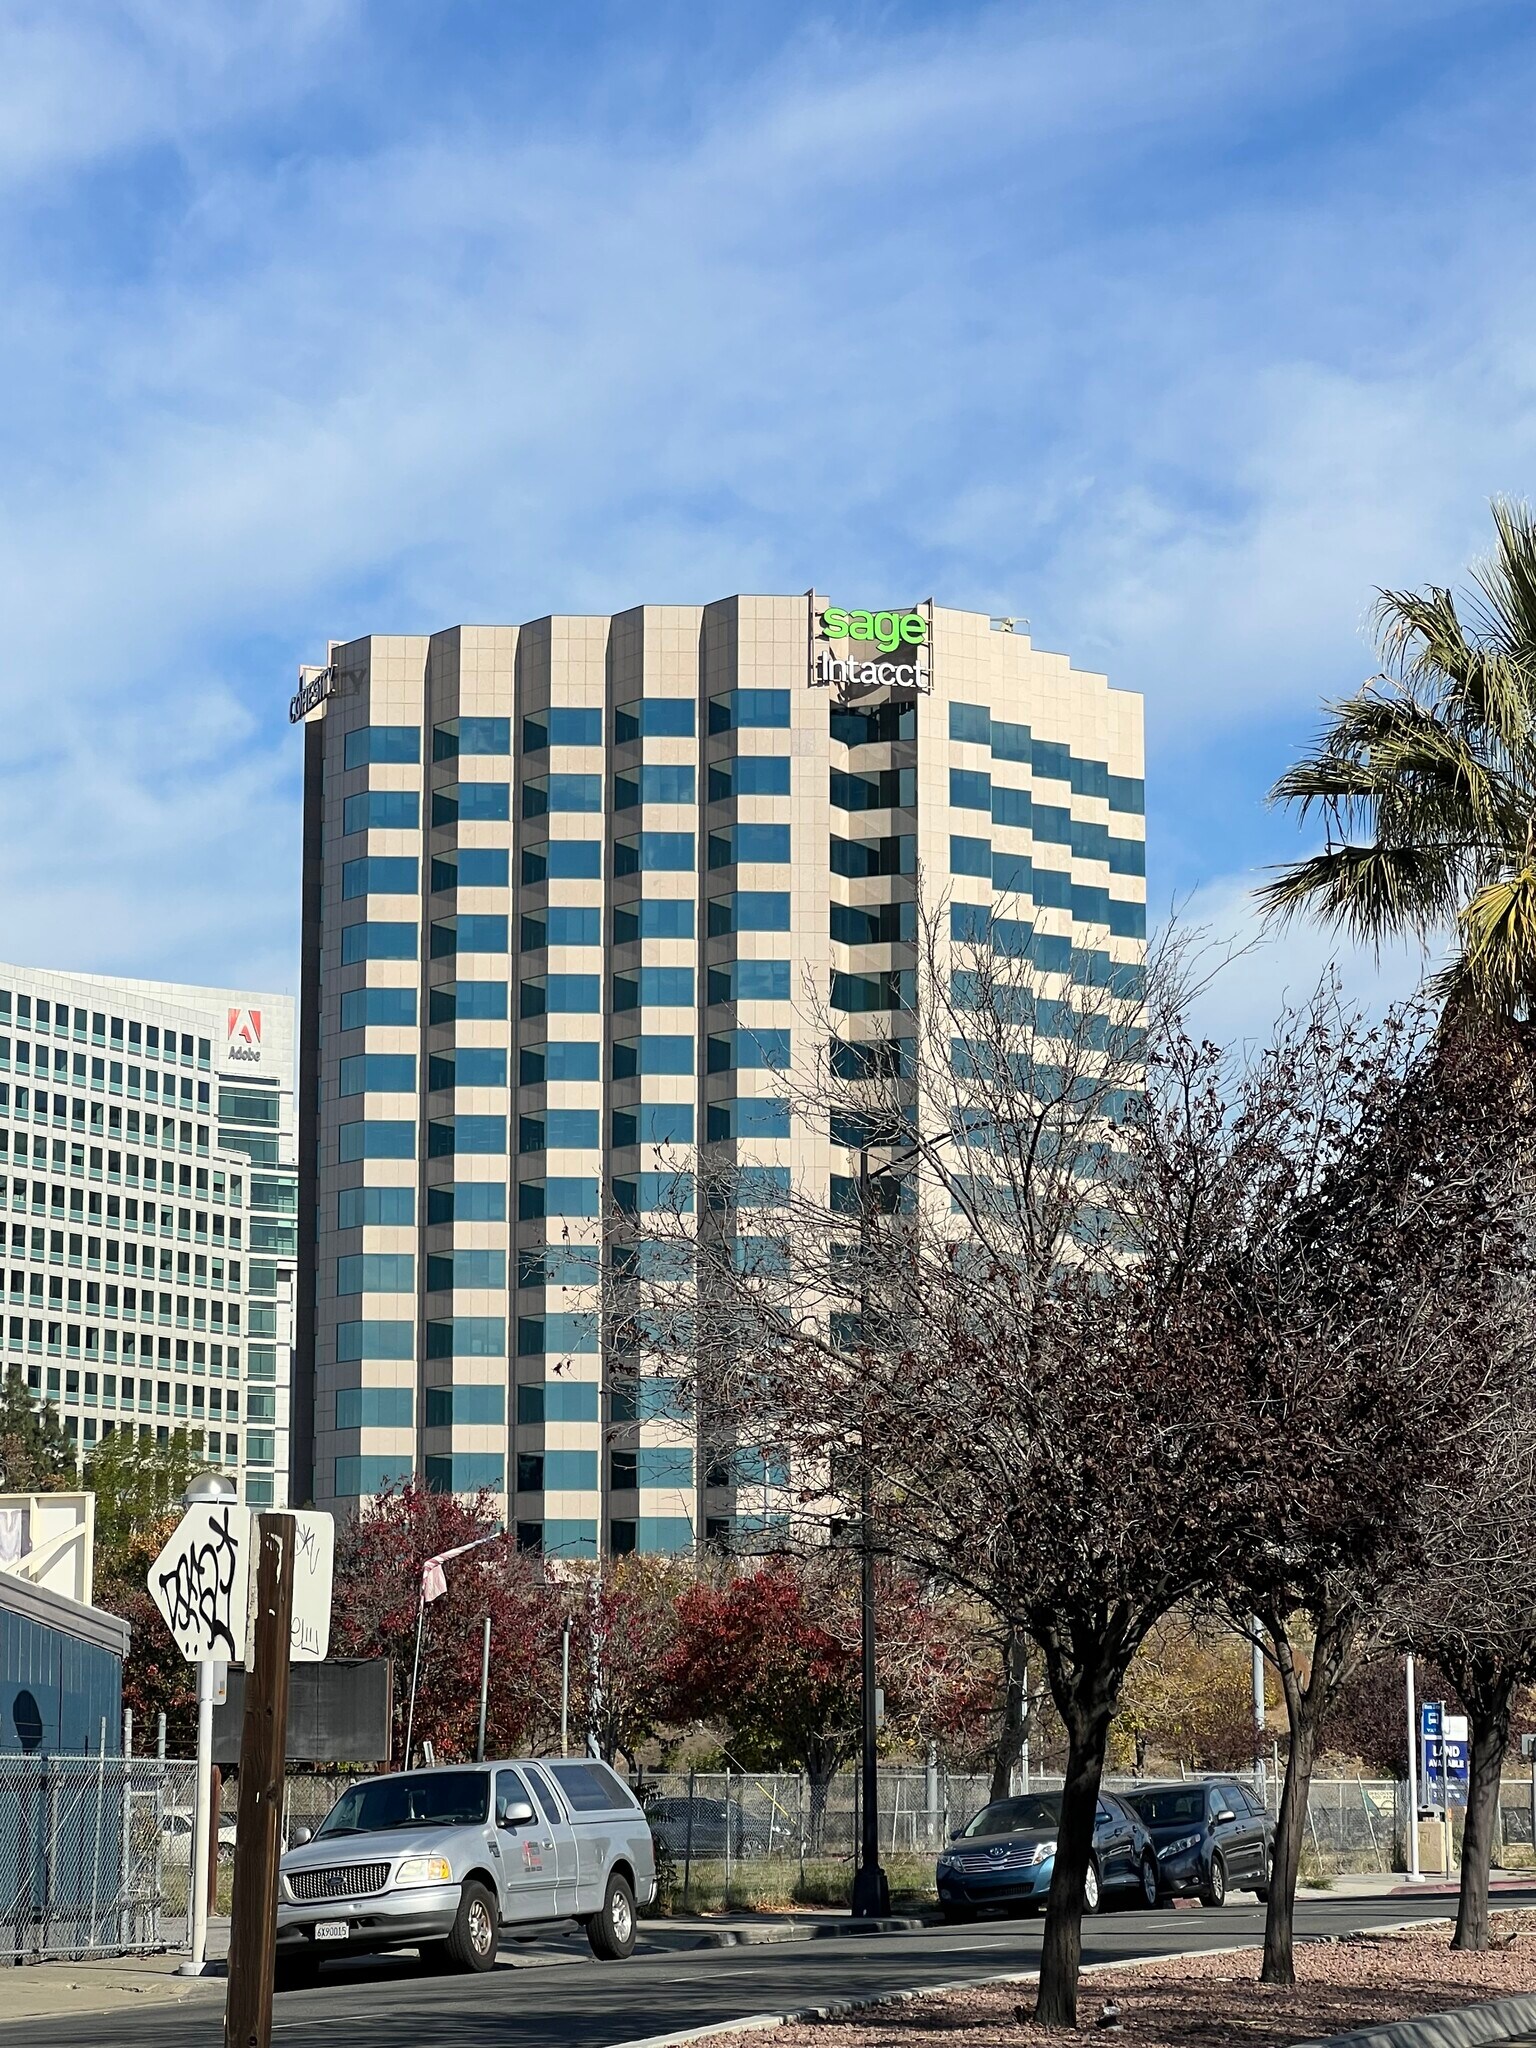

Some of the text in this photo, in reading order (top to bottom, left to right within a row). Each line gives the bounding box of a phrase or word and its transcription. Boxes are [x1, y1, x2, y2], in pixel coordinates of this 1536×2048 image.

[822, 607, 927, 653] sage
[822, 650, 929, 688] Intacct
[228, 1045, 261, 1062] Adobe
